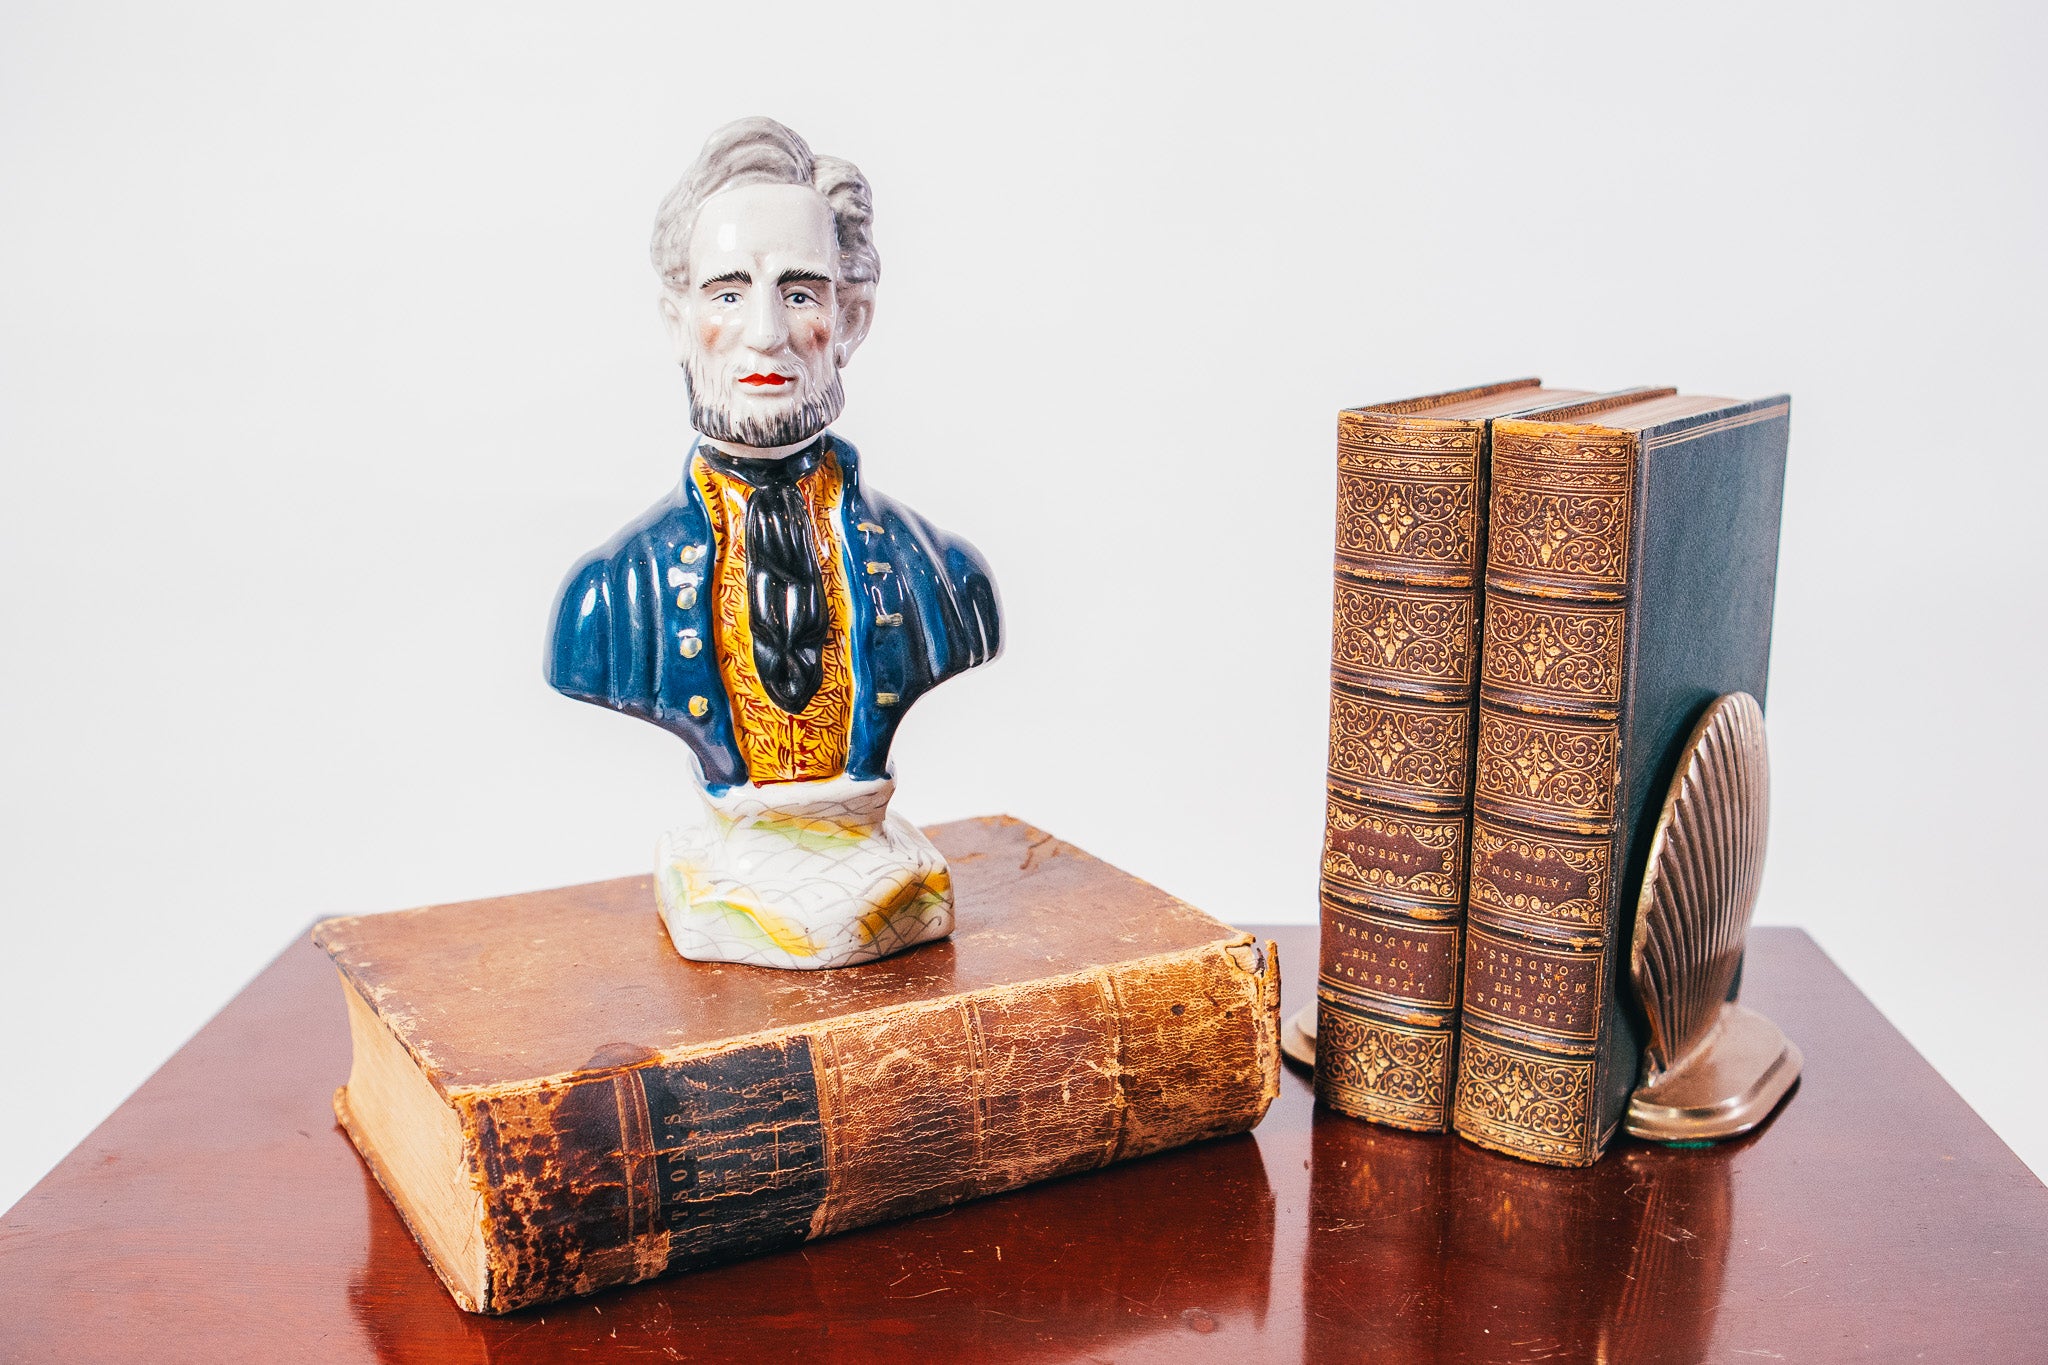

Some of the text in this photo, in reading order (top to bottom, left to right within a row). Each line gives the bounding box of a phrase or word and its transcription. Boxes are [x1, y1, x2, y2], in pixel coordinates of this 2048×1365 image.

[1341, 840, 1422, 866] JAMESON.
[1331, 920, 1428, 952] MADONNA.
[1352, 948, 1408, 970] OF THE
[1483, 947, 1568, 976] ORDERS.
[1335, 962, 1425, 993] LEGENDS
[1477, 960, 1586, 994] MONASTIC
[1477, 992, 1572, 1024] LEGENDS
[1494, 982, 1556, 1005] OF THE
